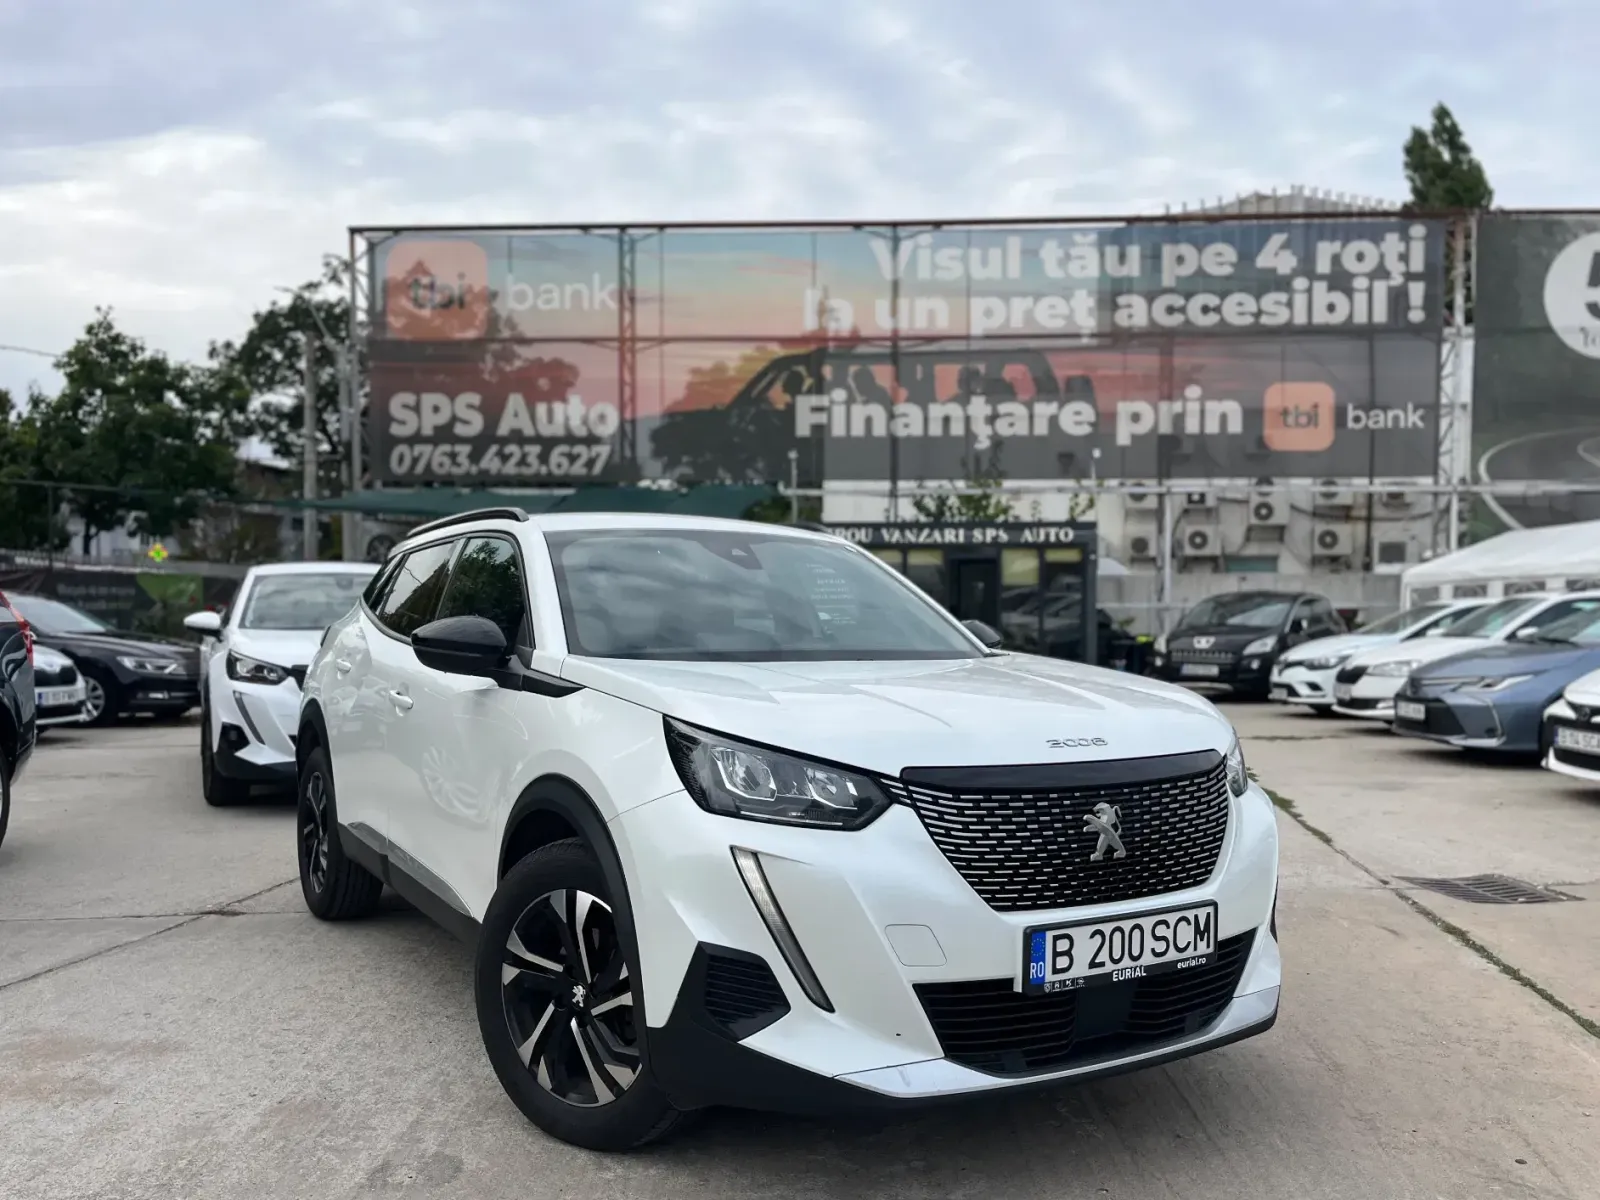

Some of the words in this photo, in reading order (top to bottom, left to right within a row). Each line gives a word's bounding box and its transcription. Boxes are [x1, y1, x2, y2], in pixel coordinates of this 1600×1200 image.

[868, 232, 1021, 280] Visul
[1039, 232, 1141, 279] tău
[1161, 241, 1239, 288] pe
[1255, 232, 1298, 275] 4
[410, 270, 466, 310] tbi
[506, 271, 619, 311] bank
[874, 294, 949, 329] un
[1113, 275, 1388, 328] accesibil
[388, 391, 485, 438] SPS
[495, 391, 619, 438] Auto
[1115, 383, 1243, 446] prin
[1280, 402, 1320, 429] tbi
[1346, 401, 1425, 430] bank
[388, 442, 612, 476] 0763.423.627
[881, 527, 965, 544] VANZARI
[971, 527, 1009, 544] SPS
[1019, 527, 1075, 544] AUTO
[1029, 961, 1045, 980] RO
[1051, 932, 1075, 976] B
[1087, 922, 1146, 971] 200
[1150, 911, 1212, 959] SCM
[1176, 956, 1207, 970] eurial.ro
